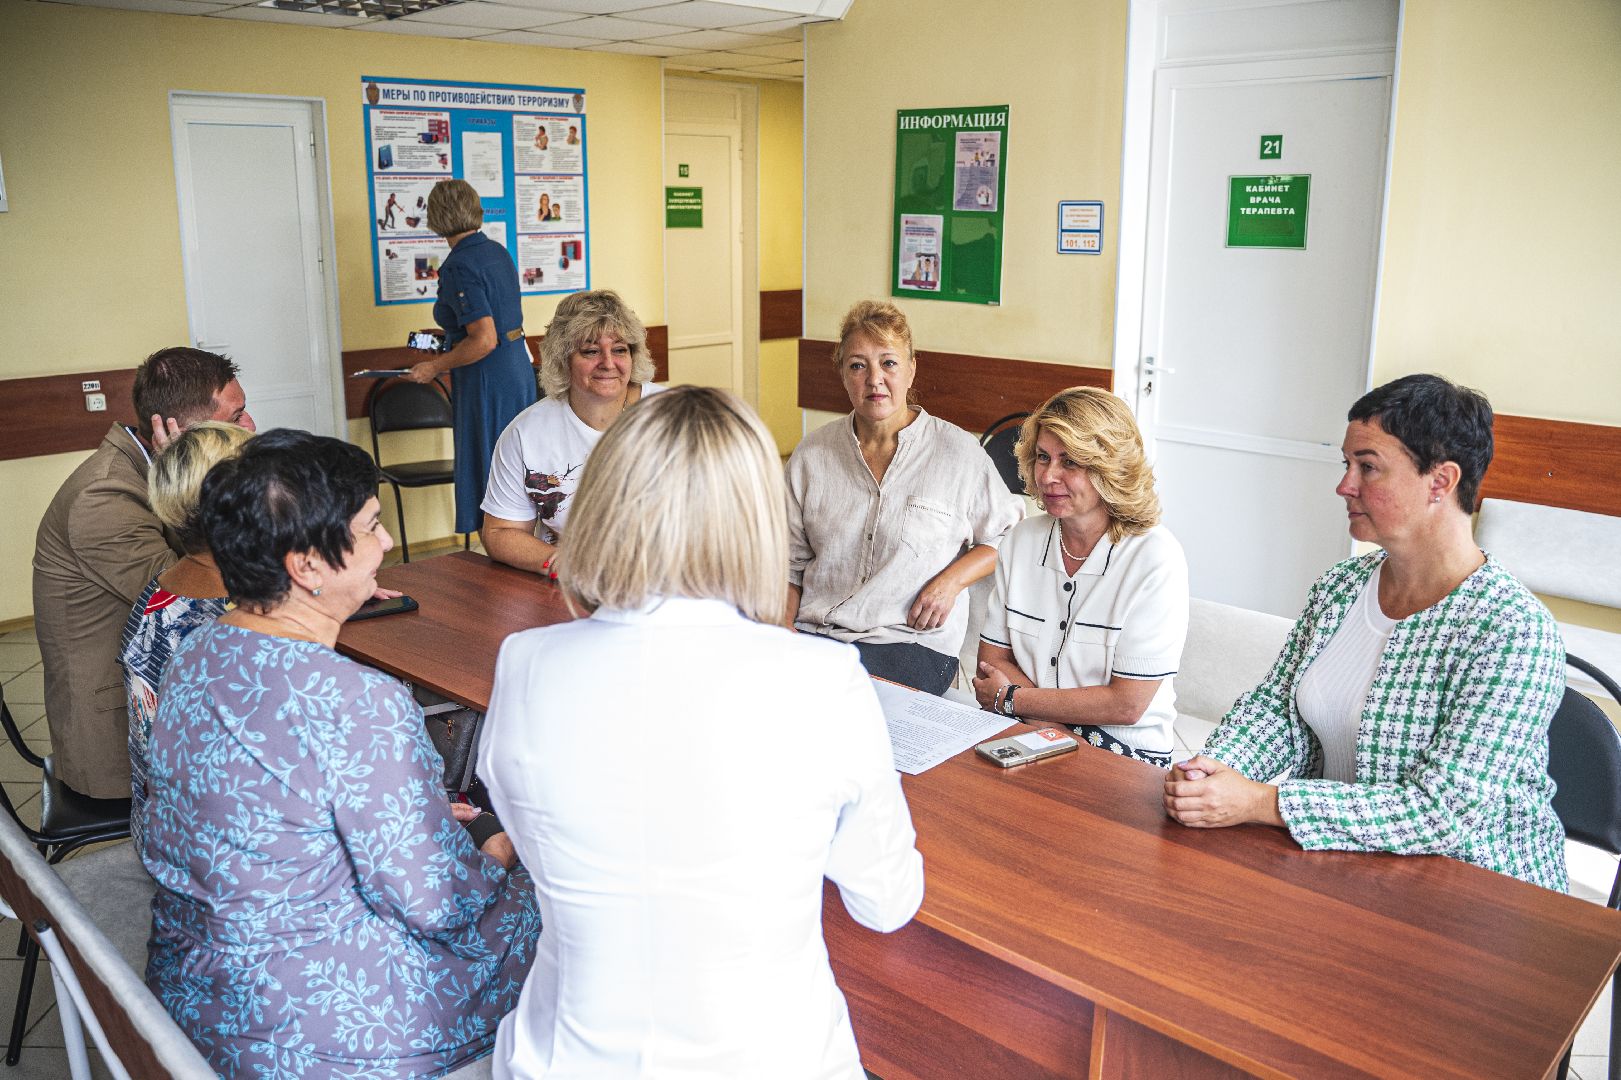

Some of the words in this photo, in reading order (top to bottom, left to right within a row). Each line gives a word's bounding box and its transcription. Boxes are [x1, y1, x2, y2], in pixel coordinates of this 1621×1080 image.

[382, 88, 410, 101] МЕРЫ
[413, 90, 426, 102] ПО
[429, 90, 515, 106] ПРОТИВОДЕЙСТВИЮ
[517, 95, 569, 108] ТЕРРОРИЗМУ
[899, 112, 1007, 130] ИНФОРМАЦИЯ
[1263, 140, 1280, 154] 21
[1245, 185, 1290, 193] КАБИНЕТ
[1249, 196, 1281, 204] ВРАЧА
[1240, 207, 1296, 215] ТЕРАПЕВТА
[1083, 240, 1096, 248] 112
